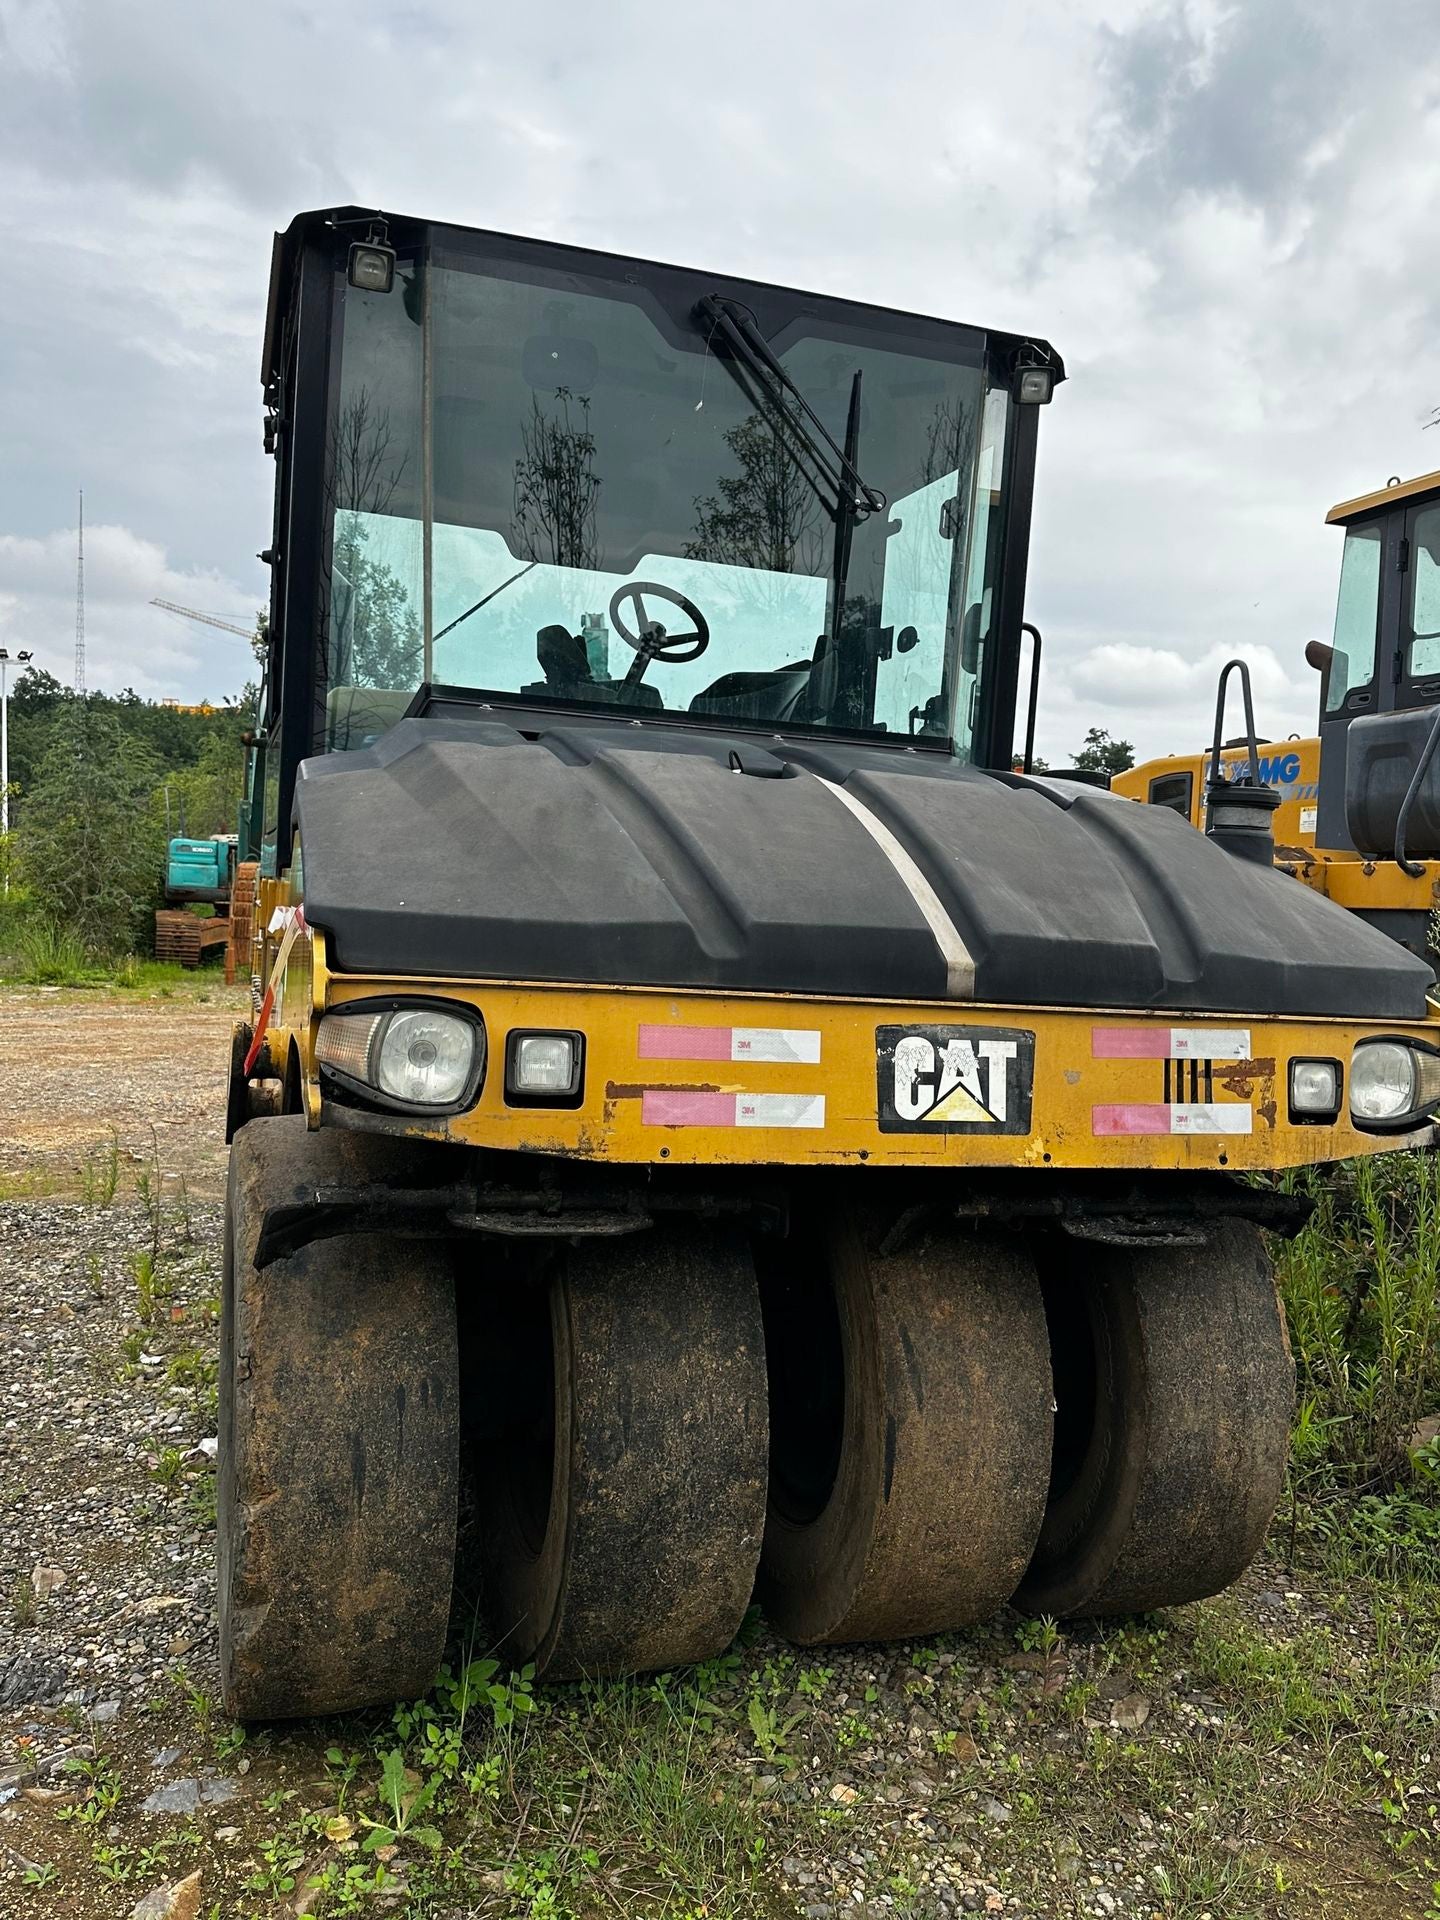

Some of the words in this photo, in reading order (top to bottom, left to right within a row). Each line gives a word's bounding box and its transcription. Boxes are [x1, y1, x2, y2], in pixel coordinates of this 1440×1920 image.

[737, 1041, 751, 1049] 3M
[1176, 1040, 1188, 1048] 3M
[894, 1036, 1018, 1122] CAT
[742, 1106, 755, 1115] 3M
[1176, 1115, 1188, 1123] 3M
